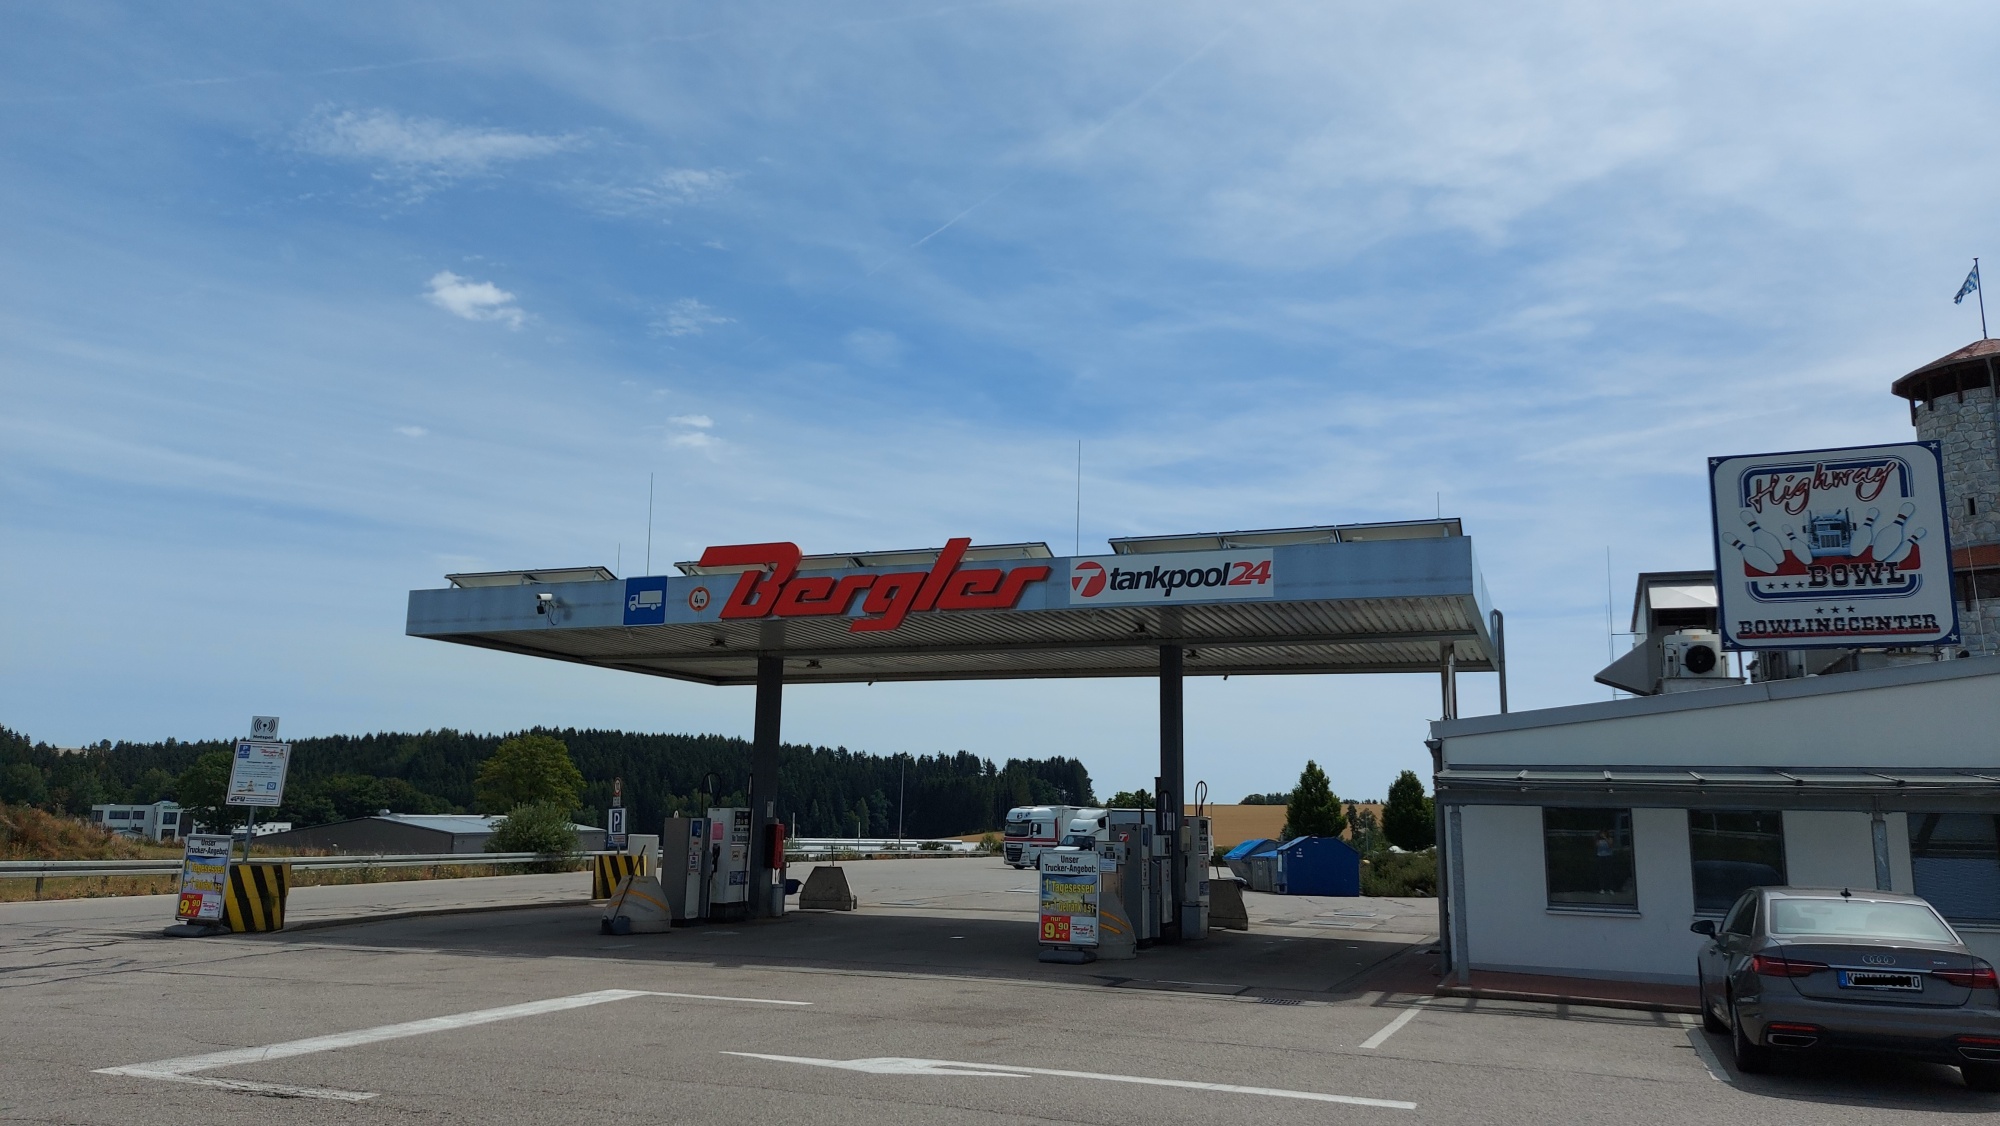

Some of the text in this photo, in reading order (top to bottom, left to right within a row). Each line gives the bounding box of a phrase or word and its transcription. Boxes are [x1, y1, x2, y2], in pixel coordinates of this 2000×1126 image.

[1748, 463, 1896, 515] Highway
[697, 537, 1051, 632] Bergler
[1110, 560, 1272, 597] tankpool24
[1808, 562, 1905, 588] BOWL
[694, 594, 699, 605] 4
[1738, 613, 1939, 636] BOWLINGCENTER
[614, 813, 620, 832] P
[1132, 824, 1137, 832] 4
[1044, 863, 1096, 875] Trucker-Angebot:
[1060, 855, 1080, 864] Unser
[1045, 878, 1095, 896] 1 Tagesessen
